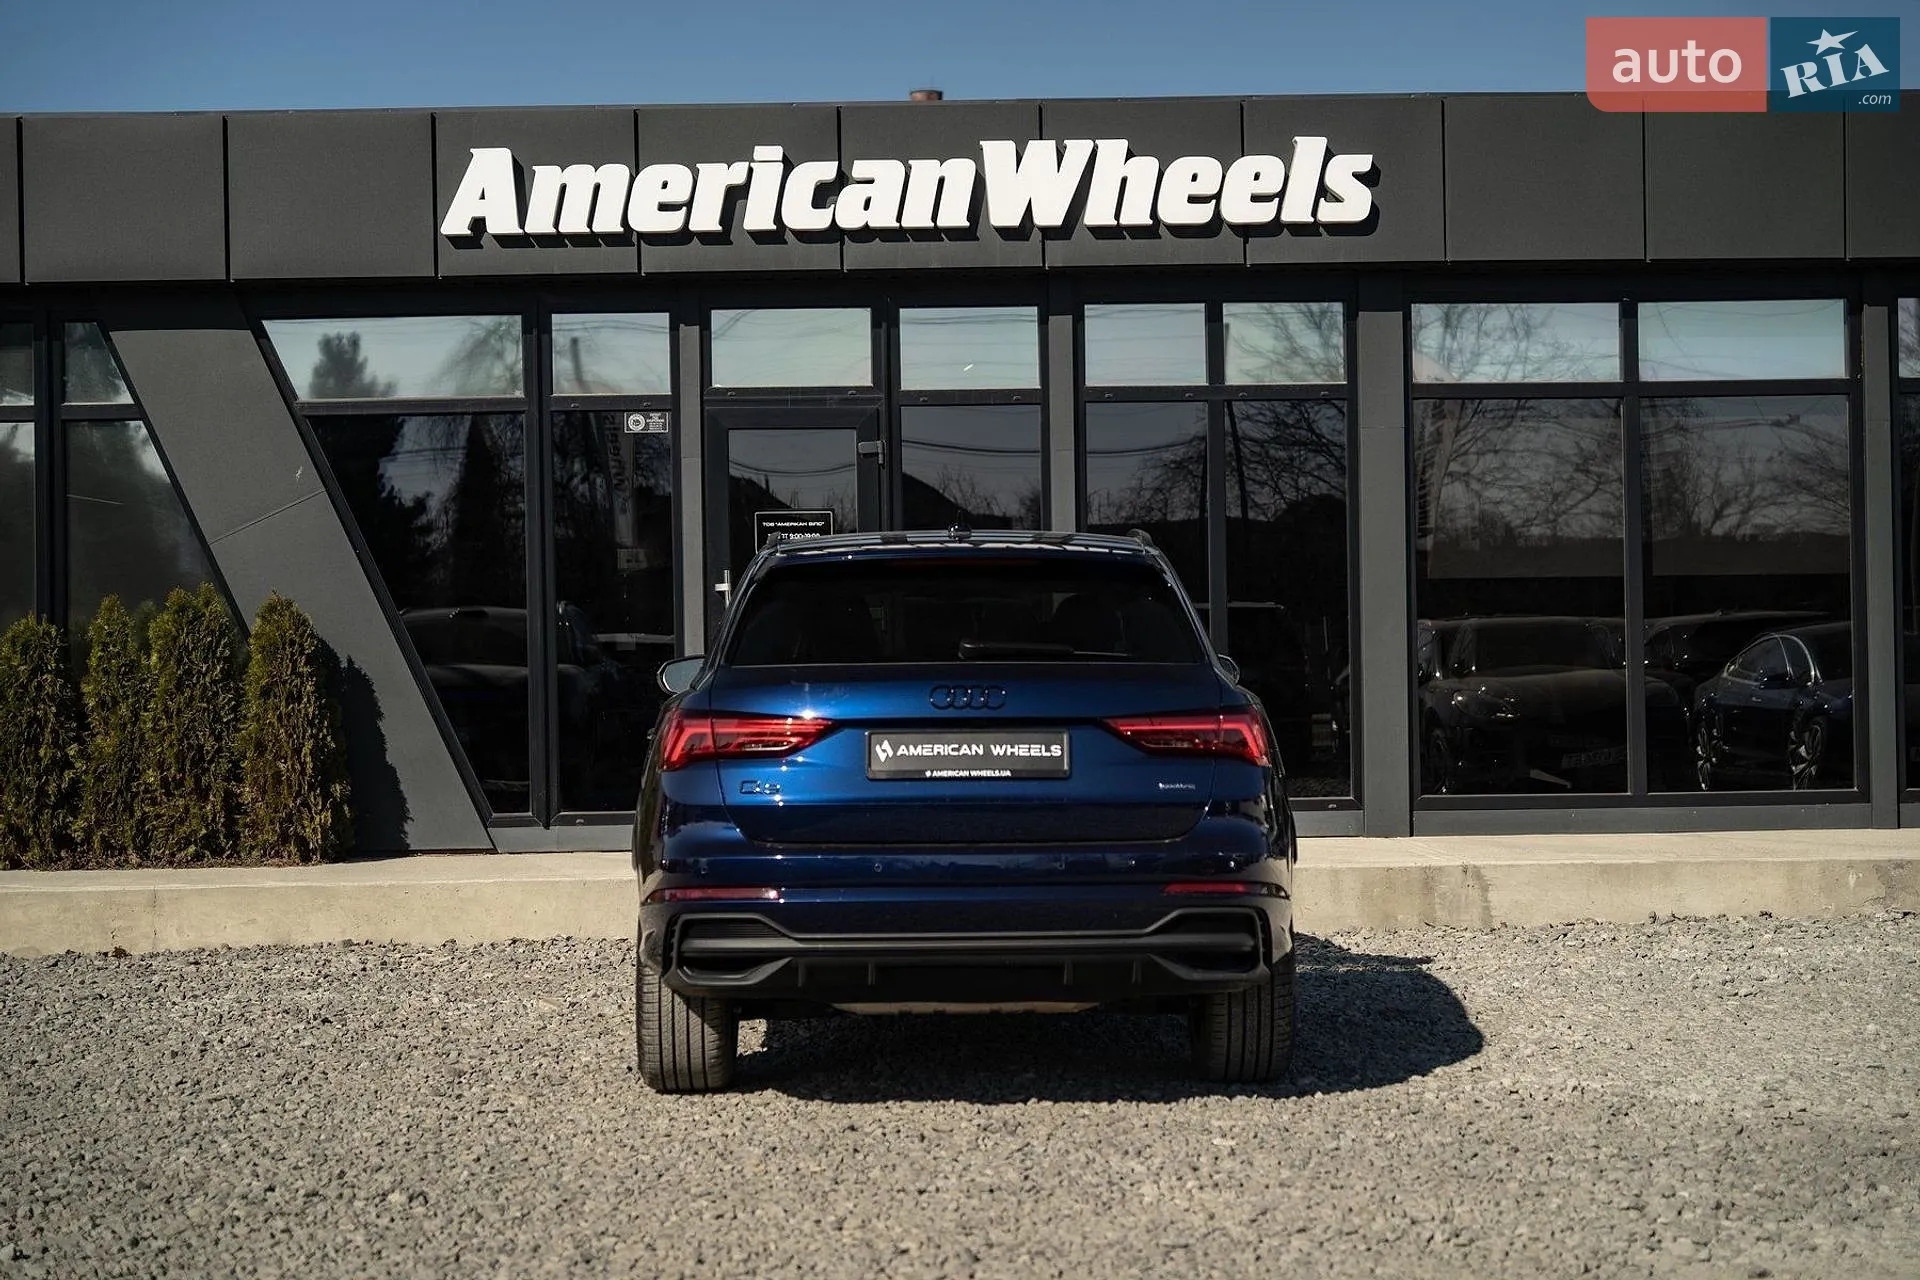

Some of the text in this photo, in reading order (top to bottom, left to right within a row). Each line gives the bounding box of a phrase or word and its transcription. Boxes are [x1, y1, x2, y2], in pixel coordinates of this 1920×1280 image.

[896, 743, 1062, 757] AMERICAN WHEELS
[932, 769, 1012, 777] AMERICAN WHEELS.UA
